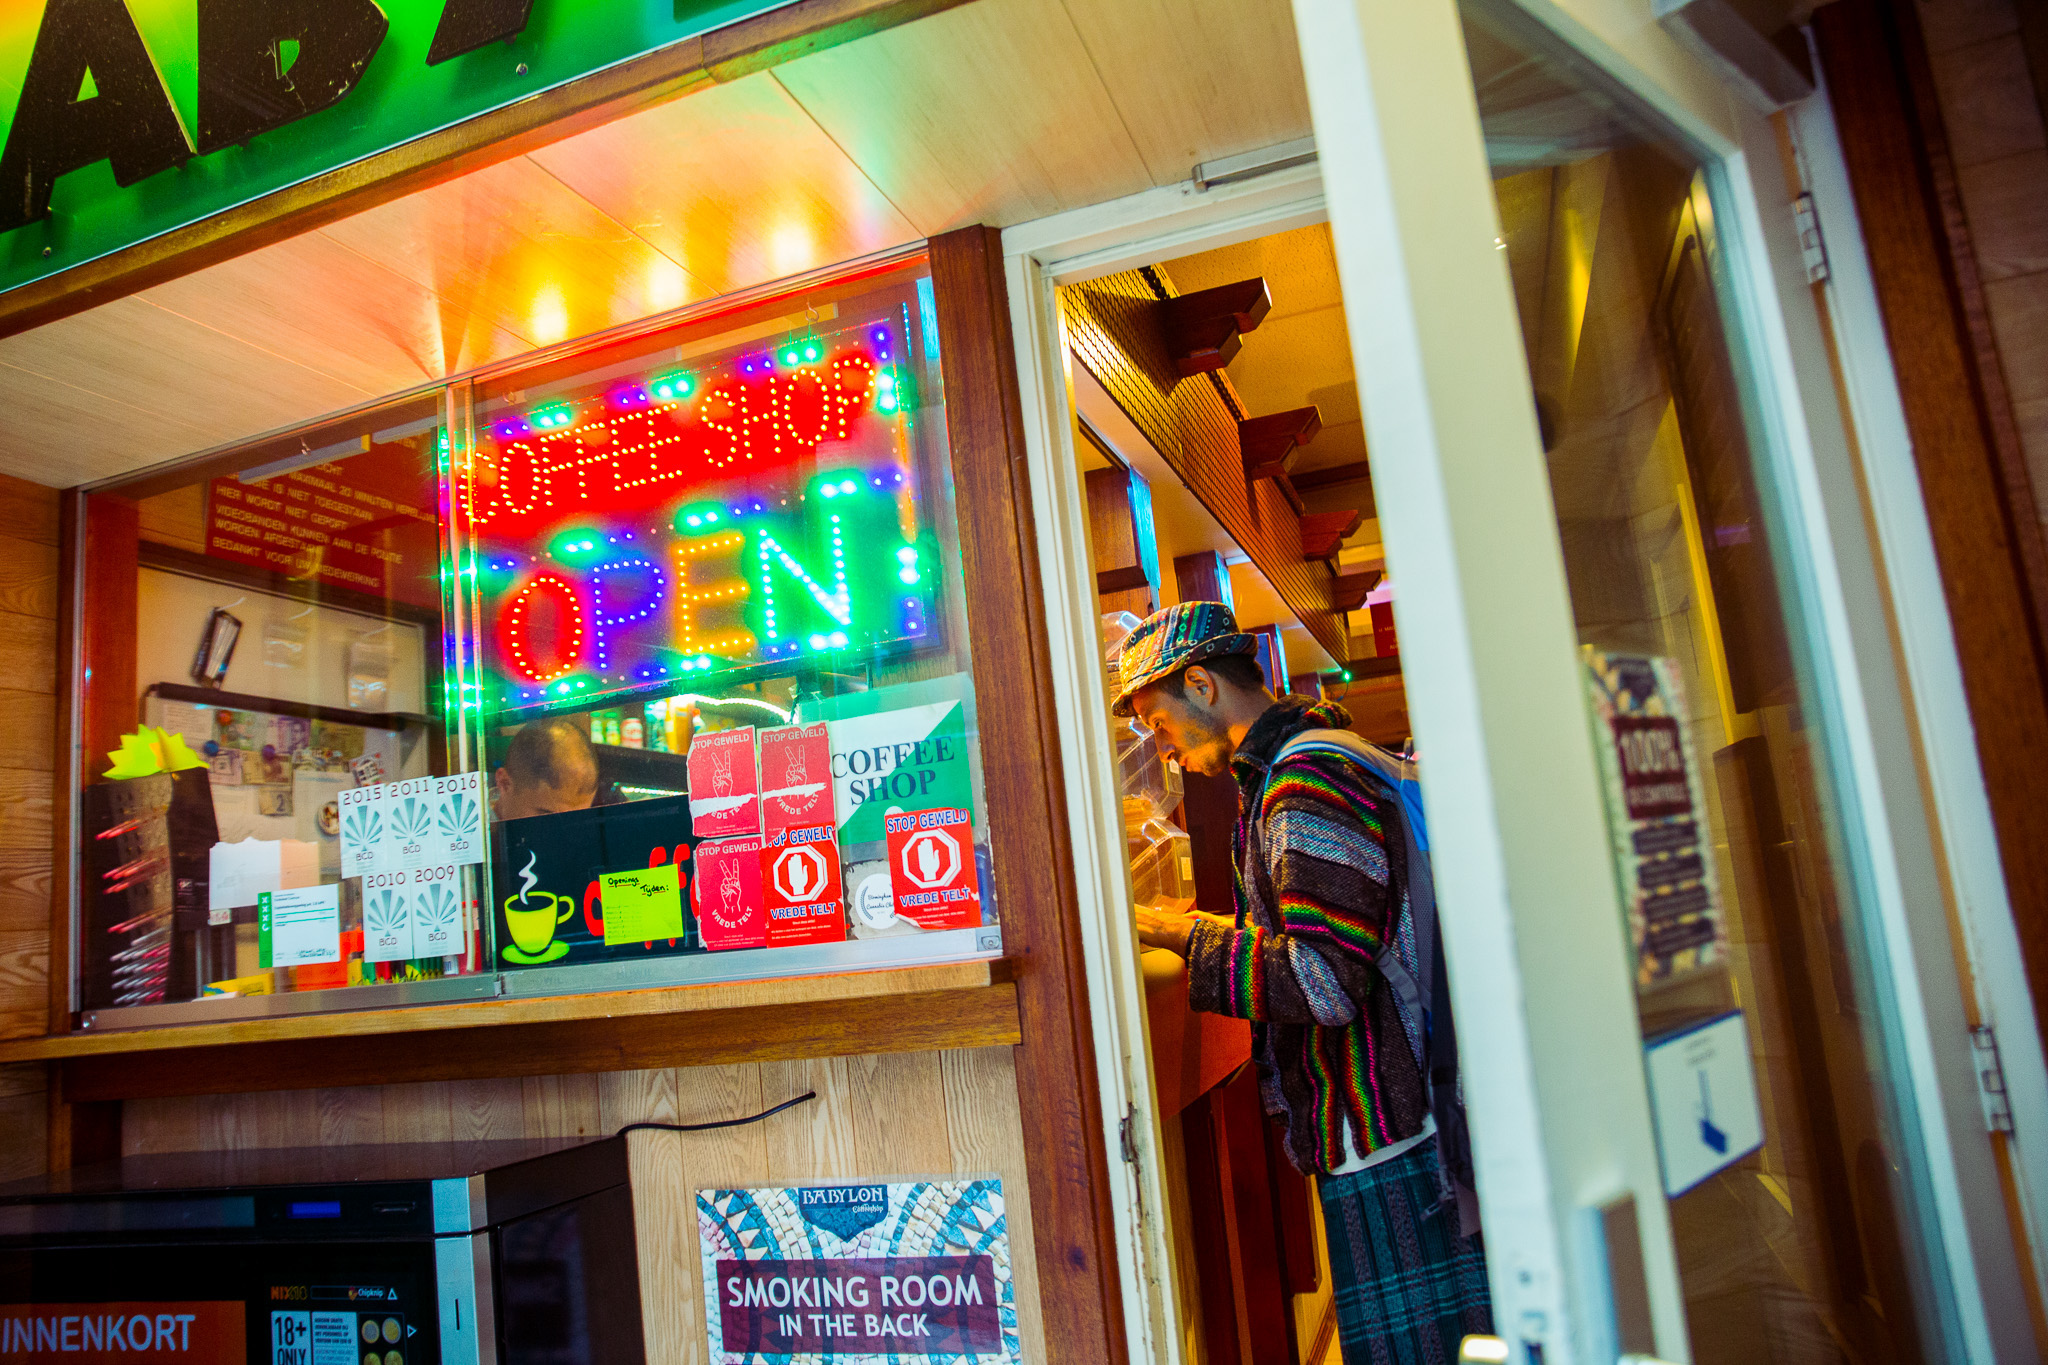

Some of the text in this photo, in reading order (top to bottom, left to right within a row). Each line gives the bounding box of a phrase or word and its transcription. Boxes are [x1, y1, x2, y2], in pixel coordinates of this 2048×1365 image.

[458, 357, 876, 524] COFFEE SHOP
[338, 485, 352, 498] 20
[216, 485, 242, 501] HIER
[245, 493, 283, 512] WORDT
[285, 505, 309, 520] NIET
[212, 537, 263, 558] BEDANKT
[265, 550, 294, 566] VOOR
[332, 537, 354, 551] AAN
[355, 543, 369, 555] DE
[512, 514, 852, 681] OPEN
[692, 732, 750, 750] STOP GEWELD
[763, 727, 826, 744] STOP GEWELD
[832, 736, 955, 779] COFFEE
[390, 779, 429, 799] 2011
[436, 774, 477, 796] 2016
[850, 769, 936, 805] SHOP
[343, 786, 382, 806] 2015
[776, 793, 819, 815] VREDE TELT
[887, 808, 968, 833] STOP GEWELD
[789, 826, 832, 844] GEWELD
[356, 851, 375, 861] BCD
[403, 844, 422, 855] BCD
[449, 841, 469, 852] BCD
[698, 842, 759, 857] STOP GEWELD
[367, 872, 406, 889] 2010
[415, 865, 455, 883] 2009
[608, 877, 639, 888] Openings
[900, 887, 970, 907] VREDE TELT
[712, 906, 752, 928] VREDE TELT
[771, 902, 837, 920] VREDE TELT
[378, 937, 398, 947] BCD
[428, 932, 448, 942] BCD
[802, 1187, 884, 1205] BABYLON
[727, 1274, 984, 1308] SMOKING ROOM
[274, 1316, 307, 1346] 18+
[779, 1313, 931, 1337] IN THE BACK
